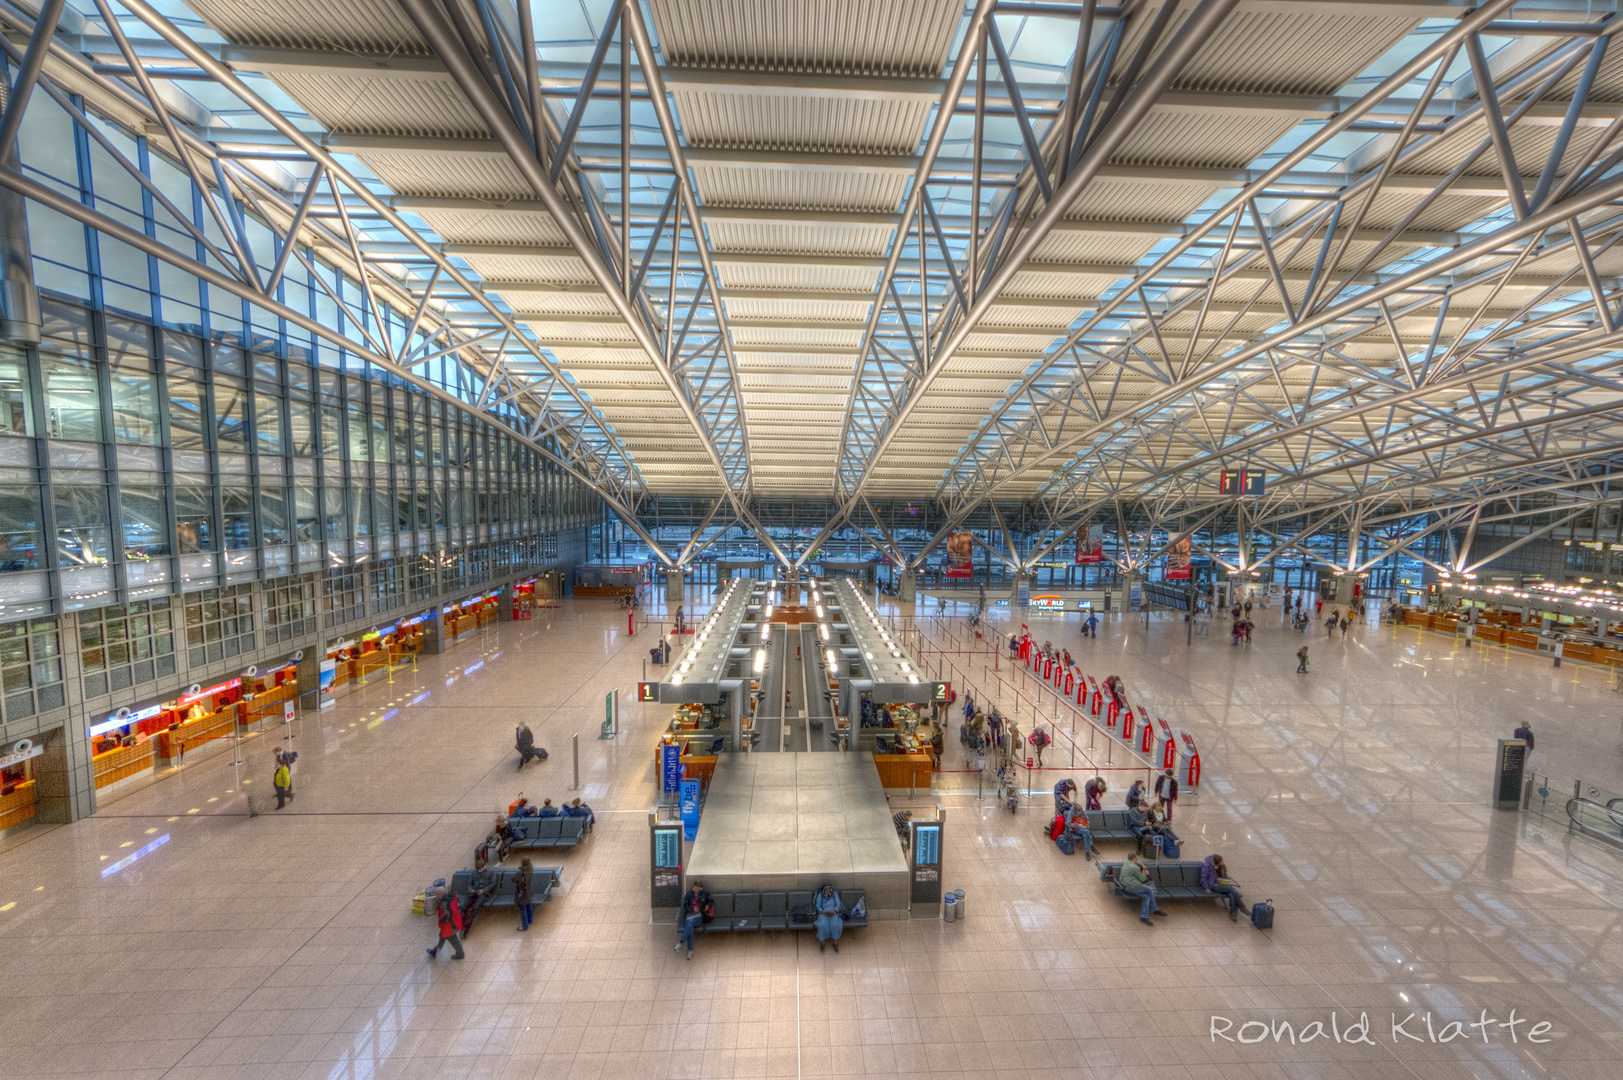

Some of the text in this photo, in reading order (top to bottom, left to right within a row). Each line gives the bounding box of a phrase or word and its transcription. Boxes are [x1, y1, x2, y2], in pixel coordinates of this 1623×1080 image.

[1225, 478, 1230, 490] 1
[1246, 478, 1252, 490] 1
[644, 684, 650, 696] 1
[938, 684, 946, 696] 2
